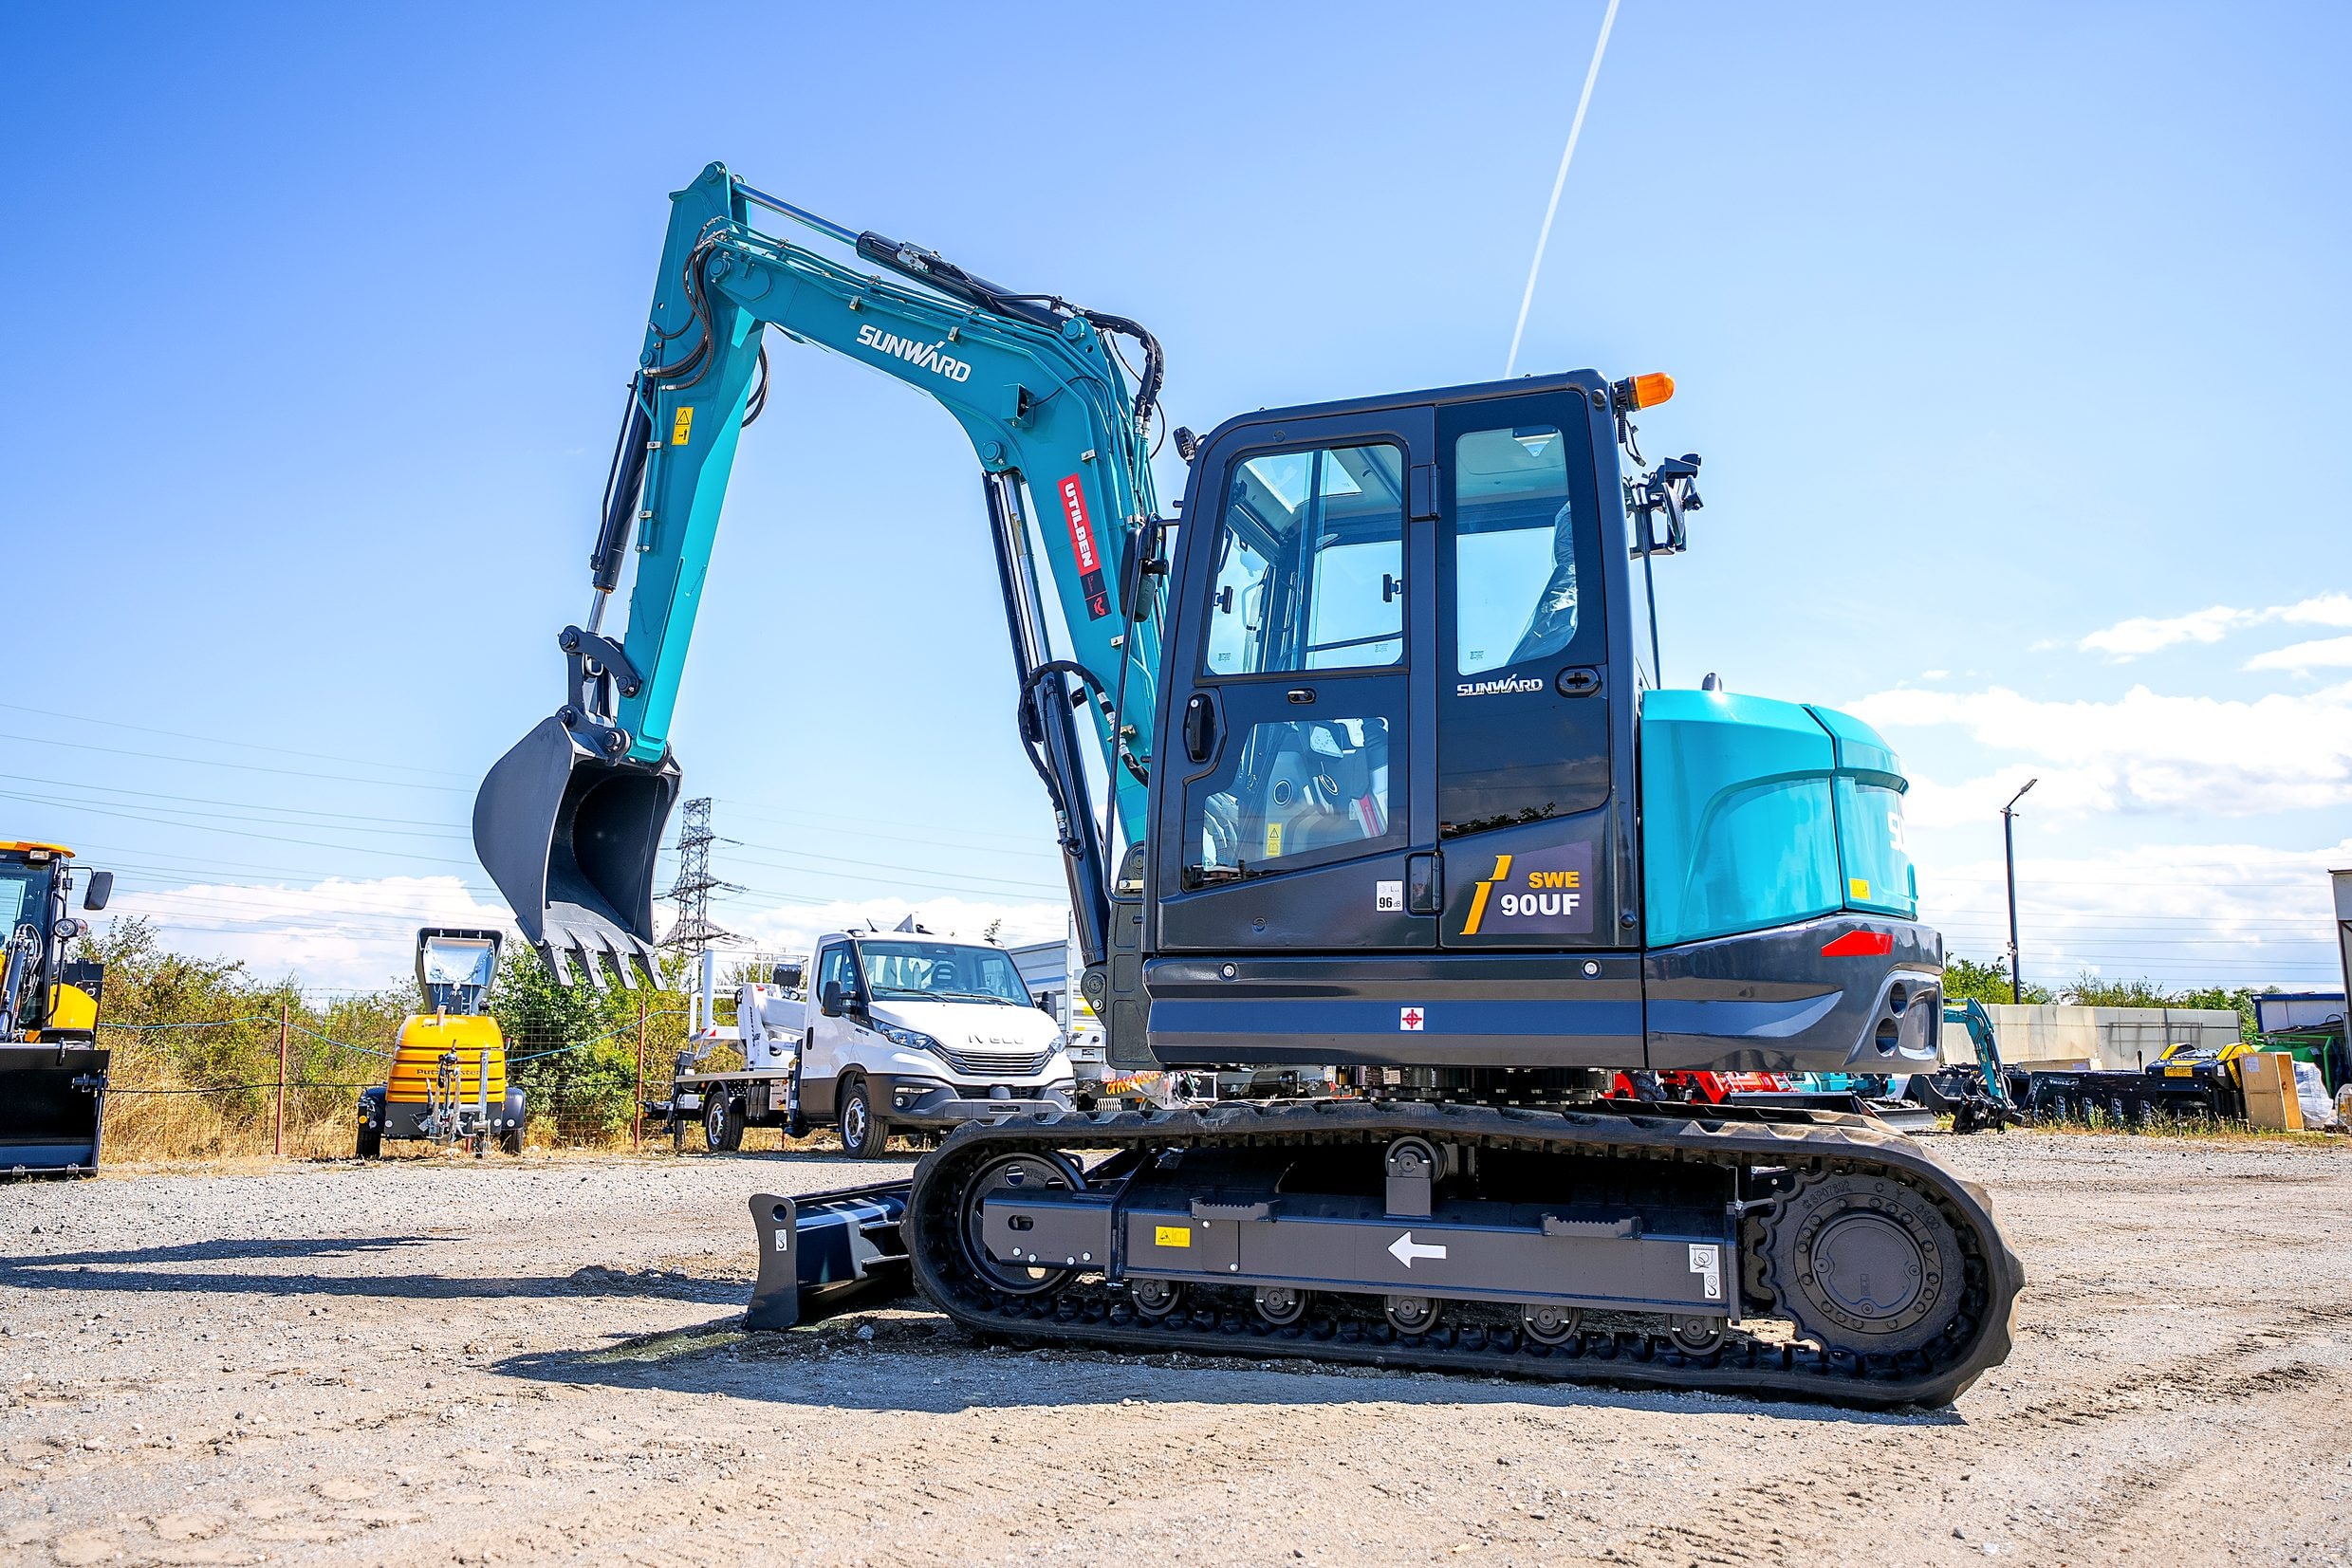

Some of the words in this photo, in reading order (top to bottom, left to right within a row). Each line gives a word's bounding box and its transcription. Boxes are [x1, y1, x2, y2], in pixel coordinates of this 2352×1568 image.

[856, 323, 972, 382] SUNWARD
[1064, 482, 1094, 568] UTILBEN
[1456, 673, 1543, 697] SUNWARD
[1528, 871, 1580, 889] SWE
[1379, 896, 1393, 909] 96
[1500, 894, 1581, 916] 90UF
